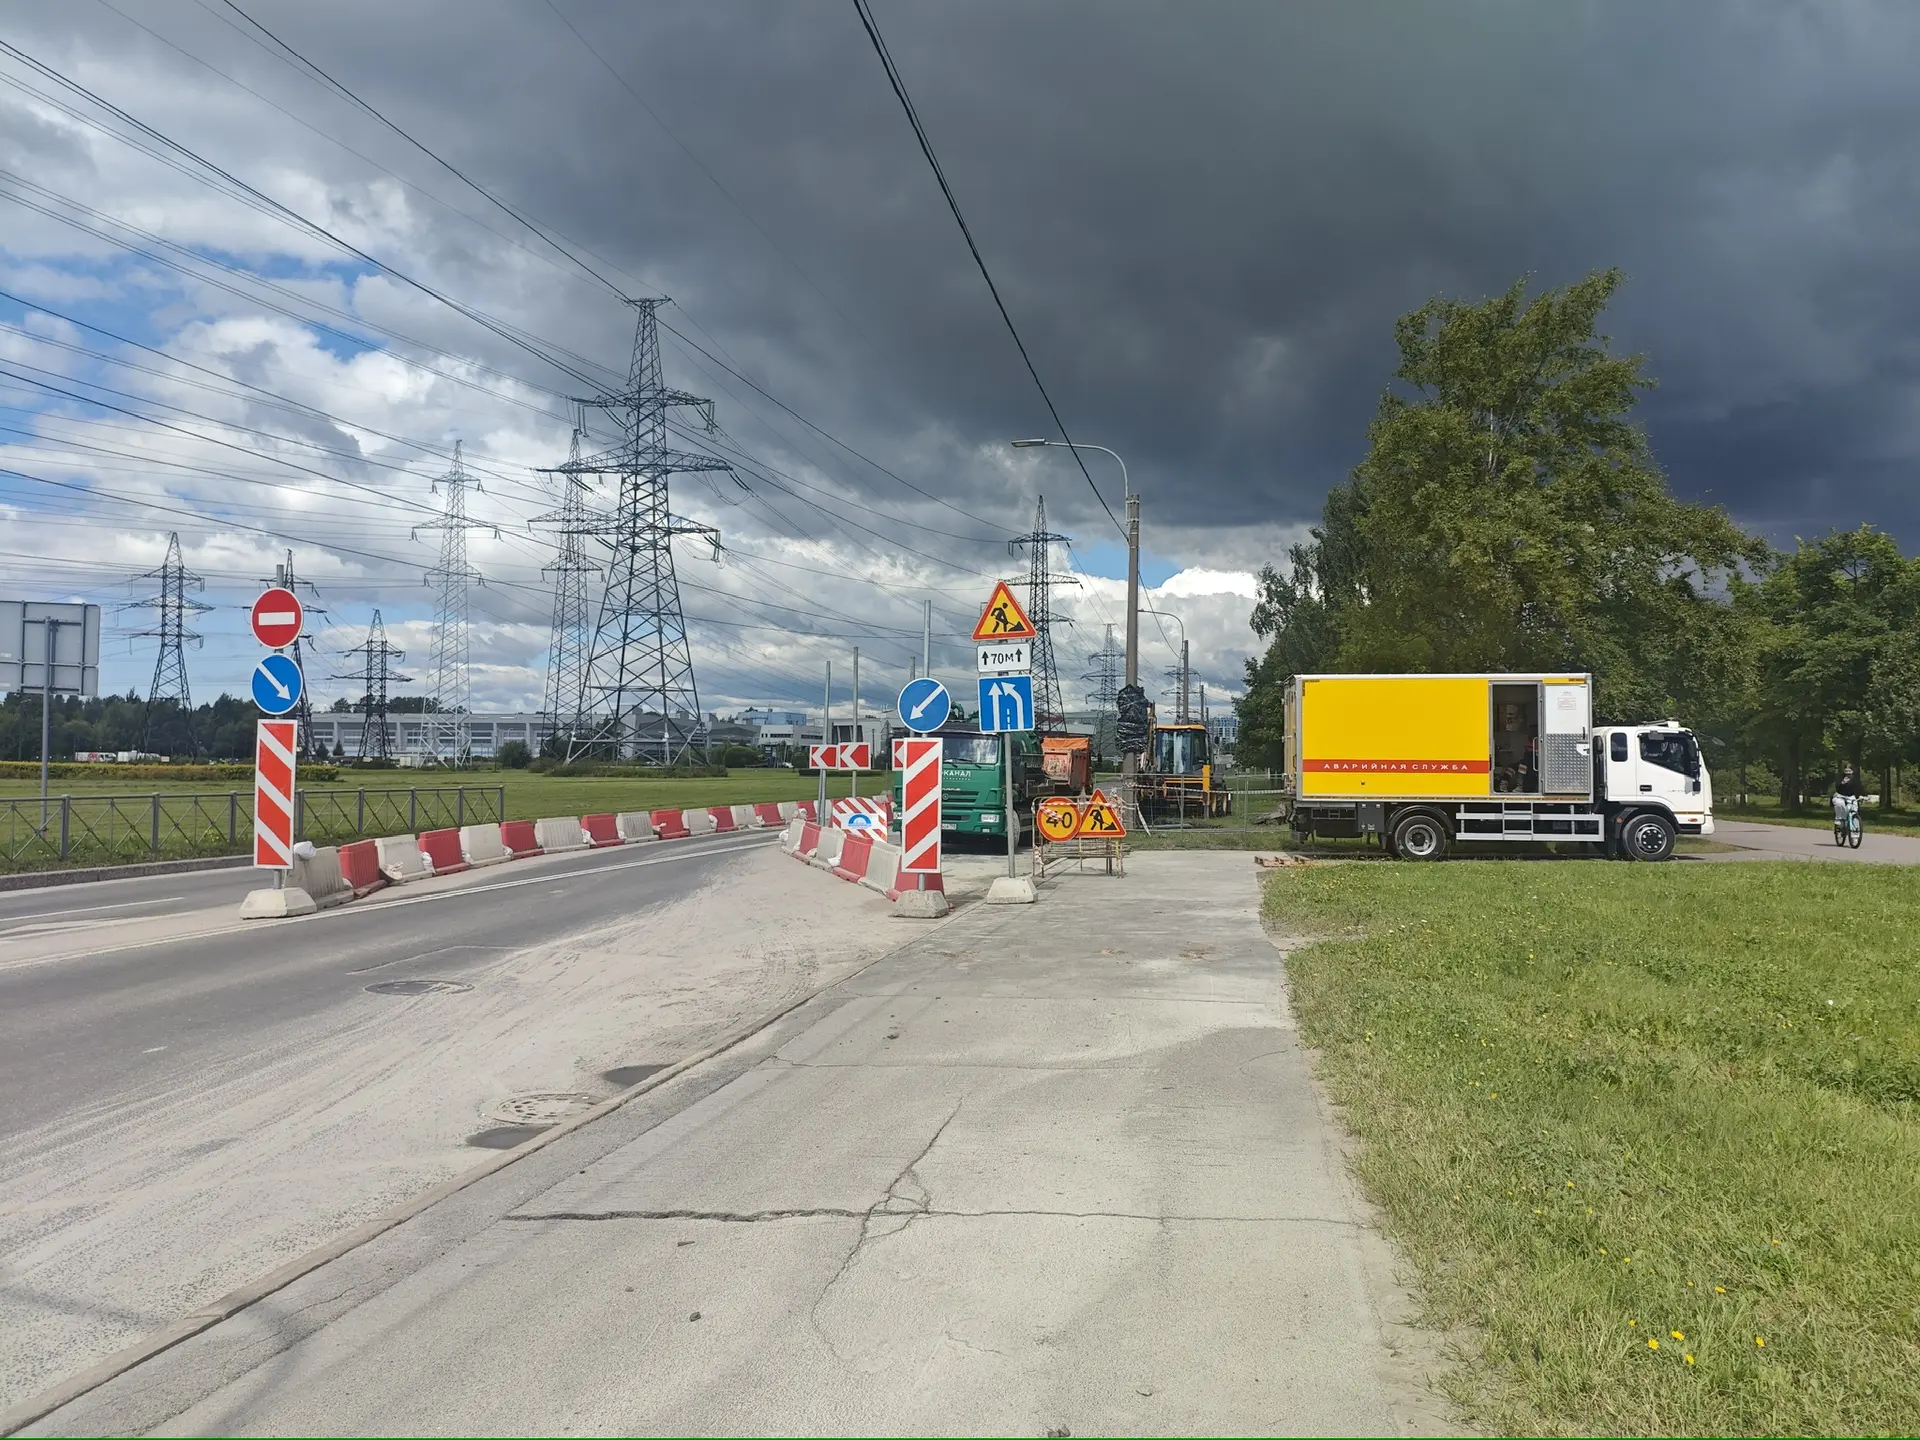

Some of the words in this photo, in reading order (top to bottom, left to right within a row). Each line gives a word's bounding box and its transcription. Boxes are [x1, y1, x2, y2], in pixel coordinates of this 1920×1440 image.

[1323, 762, 1407, 770] АВАРИЙНАЯ
[1411, 763, 1468, 771] СЛУЖБА
[1045, 811, 1073, 829] 40
